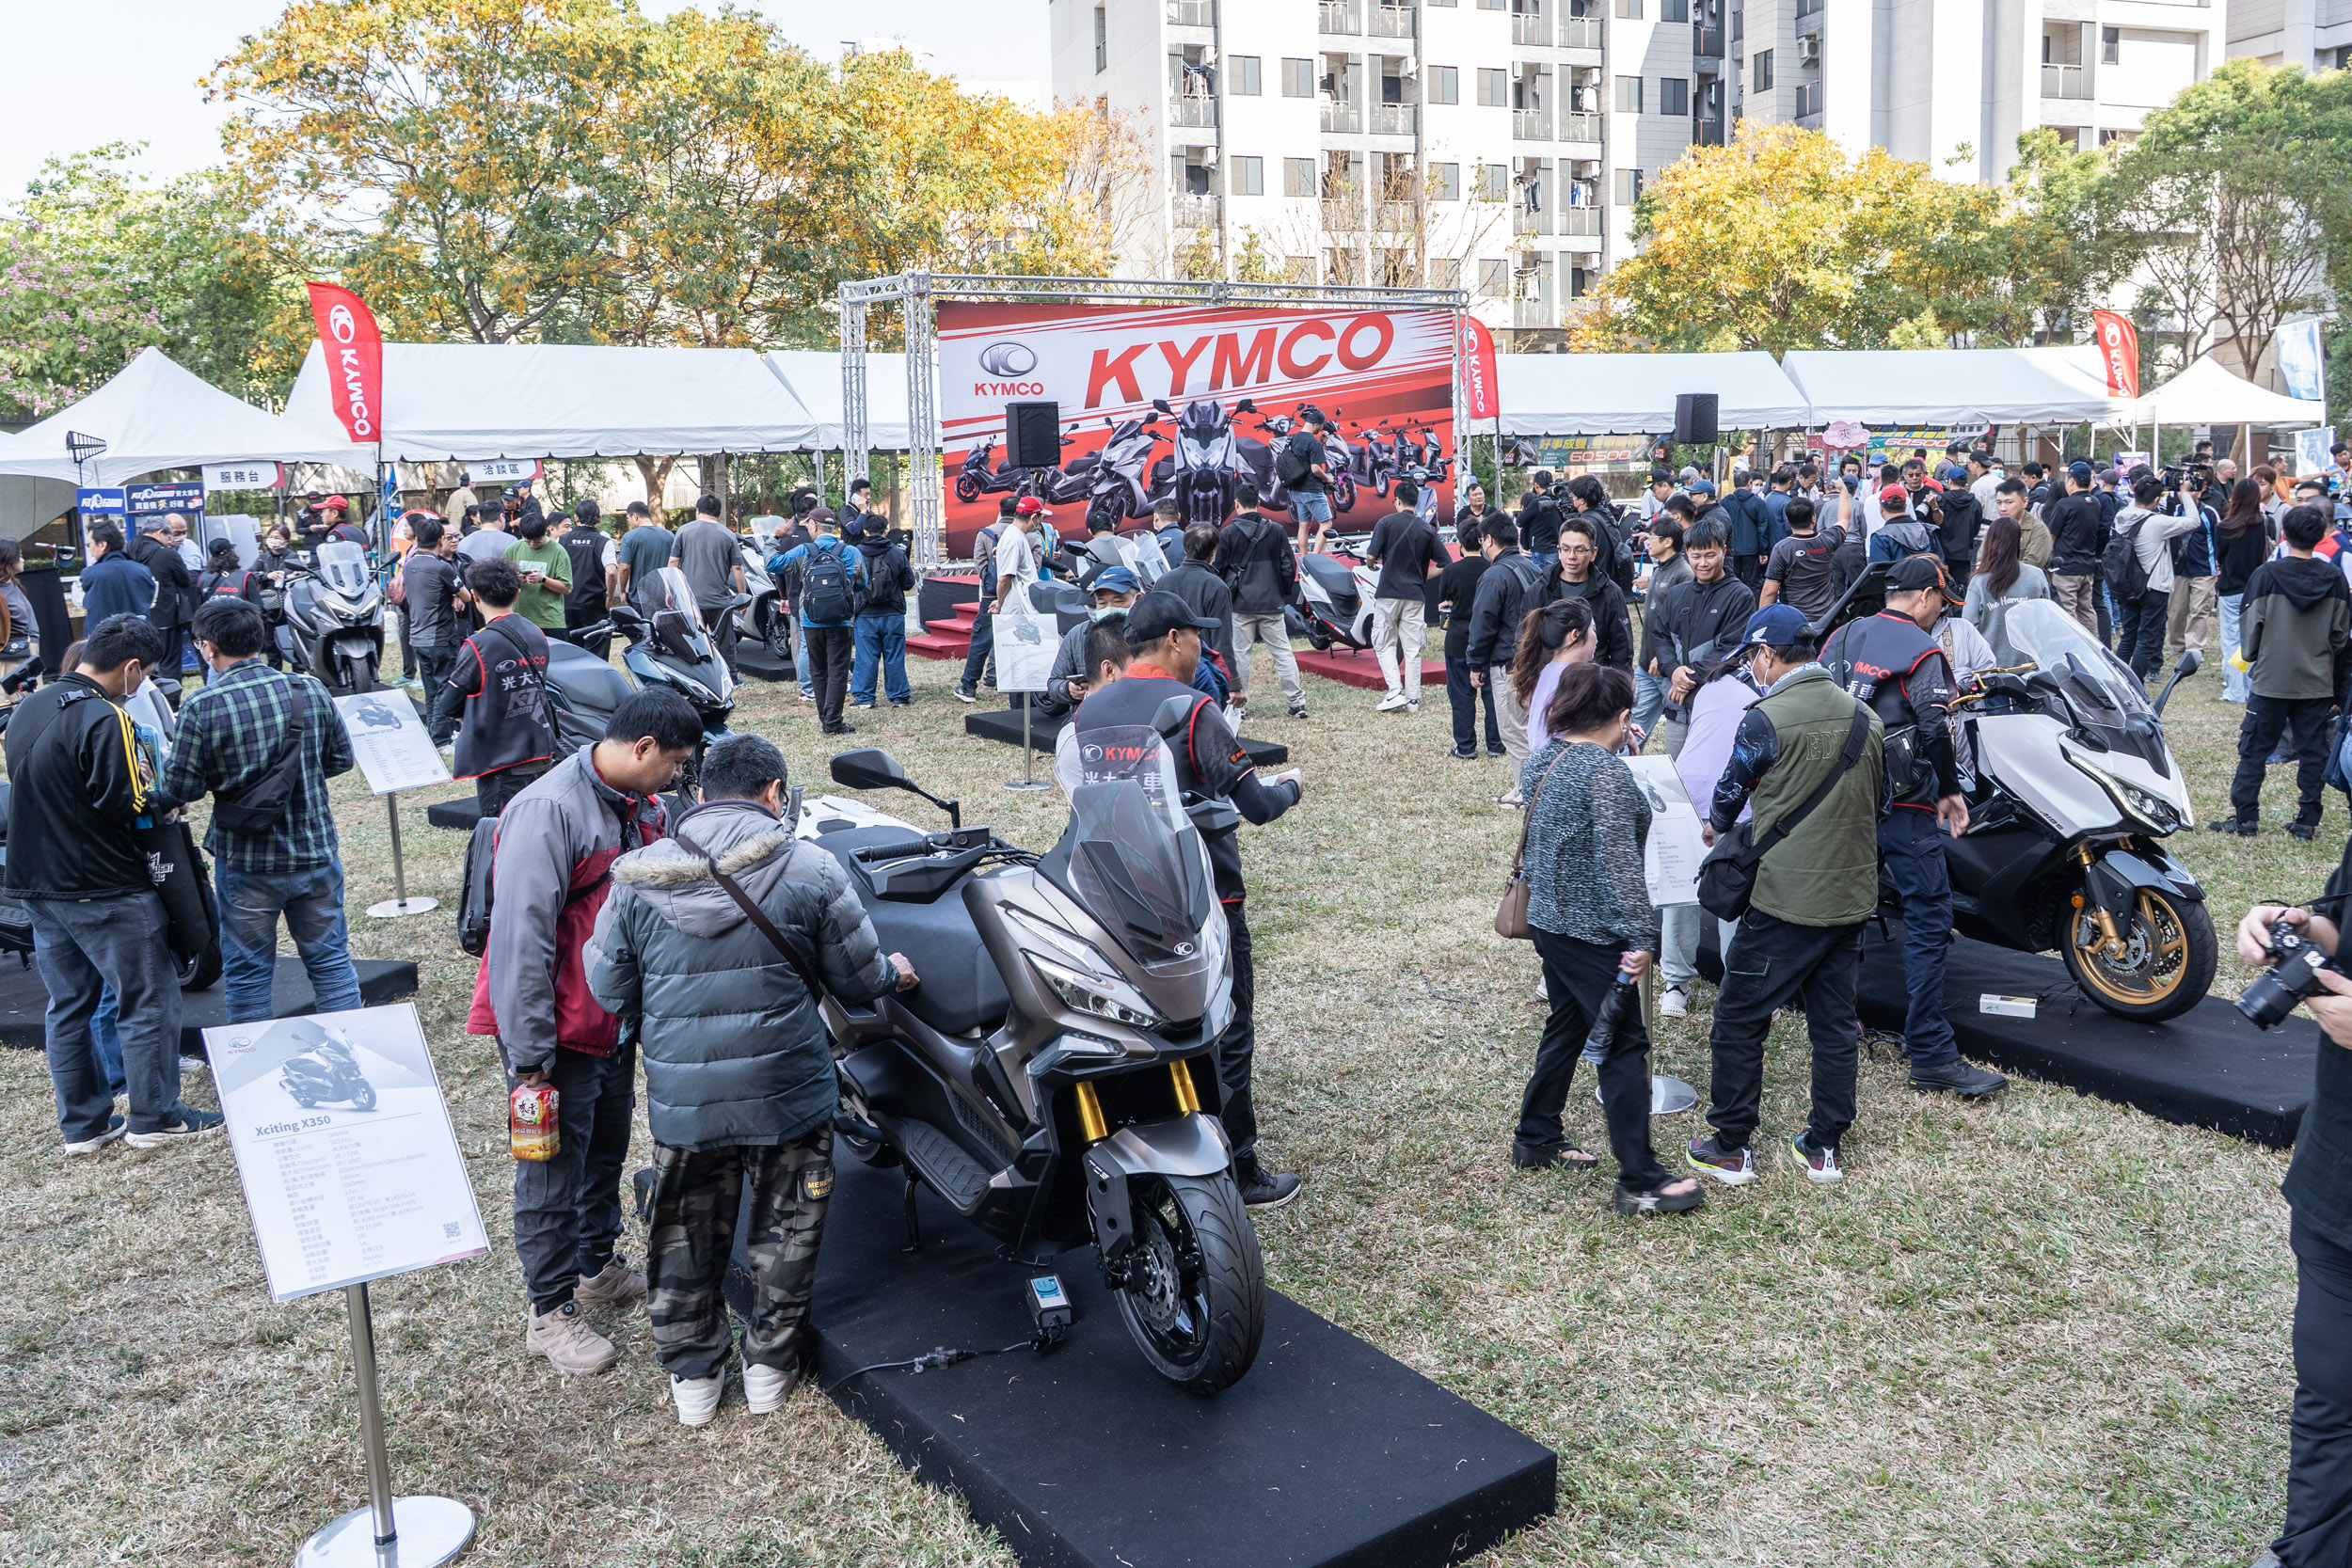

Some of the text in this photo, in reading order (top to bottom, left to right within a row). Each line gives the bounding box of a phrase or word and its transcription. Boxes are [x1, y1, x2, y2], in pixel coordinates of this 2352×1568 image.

[1085, 312, 1394, 409] KYMCO
[975, 383, 1043, 395] KYMCO
[484, 464, 519, 475] 洽談區
[220, 470, 259, 483] 服務台
[1986, 602, 2000, 611] The
[228, 1047, 256, 1055] KYMCO
[255, 1116, 331, 1136] Xciting X350
